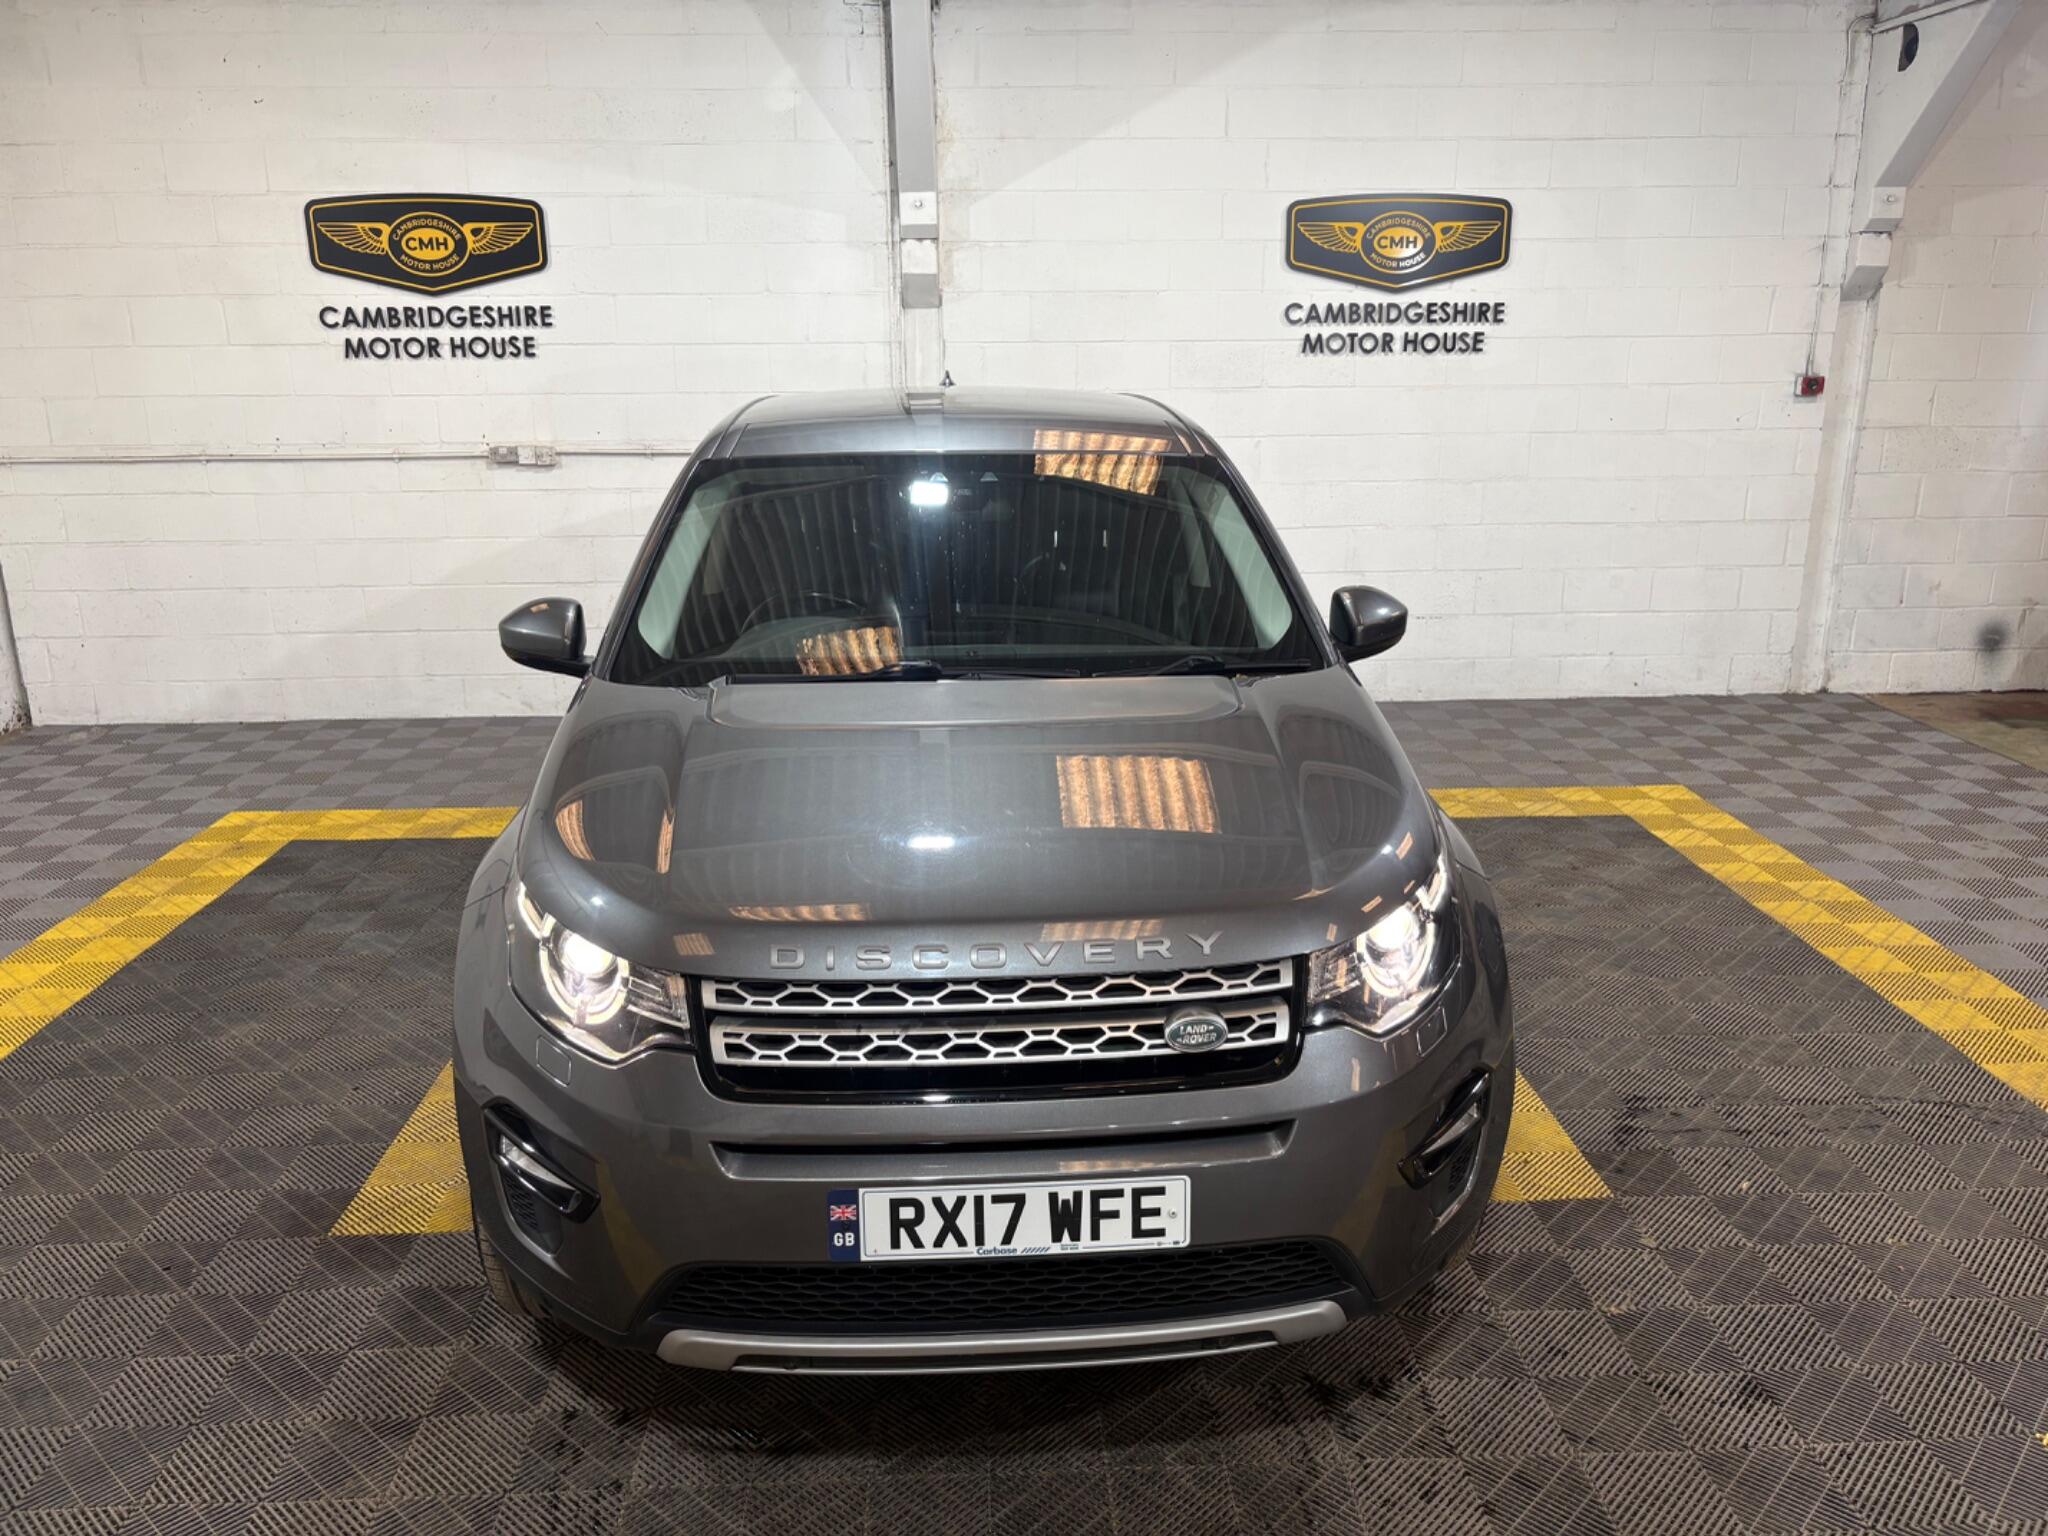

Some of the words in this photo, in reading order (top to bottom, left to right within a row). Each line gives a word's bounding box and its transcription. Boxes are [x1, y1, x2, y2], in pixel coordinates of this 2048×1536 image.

[393, 218, 461, 241] CAMBRIDGESHIRE
[1366, 217, 1432, 240] CAMBRIDGESHIRE
[405, 237, 448, 251] CMH
[1377, 235, 1418, 249] CMH
[400, 254, 431, 271] MOTOR
[432, 254, 460, 270] HOUSE
[1369, 252, 1398, 268] MOTOR
[1399, 252, 1426, 268] HOUSE
[319, 305, 553, 329] CAMBRIDGESHIRE
[1284, 302, 1506, 325] CAMBRIDGESHIRE
[345, 337, 441, 359] MOTOR
[451, 336, 536, 358] HOUSE
[1302, 332, 1394, 354] MOTOR
[1403, 331, 1485, 353] HOUSE
[769, 930, 1223, 970] DISCOVERY
[889, 1192, 1027, 1250] RX17
[1048, 1186, 1167, 1243] WFE
[833, 1231, 856, 1248] GB
[976, 1245, 1018, 1257] Carbase
